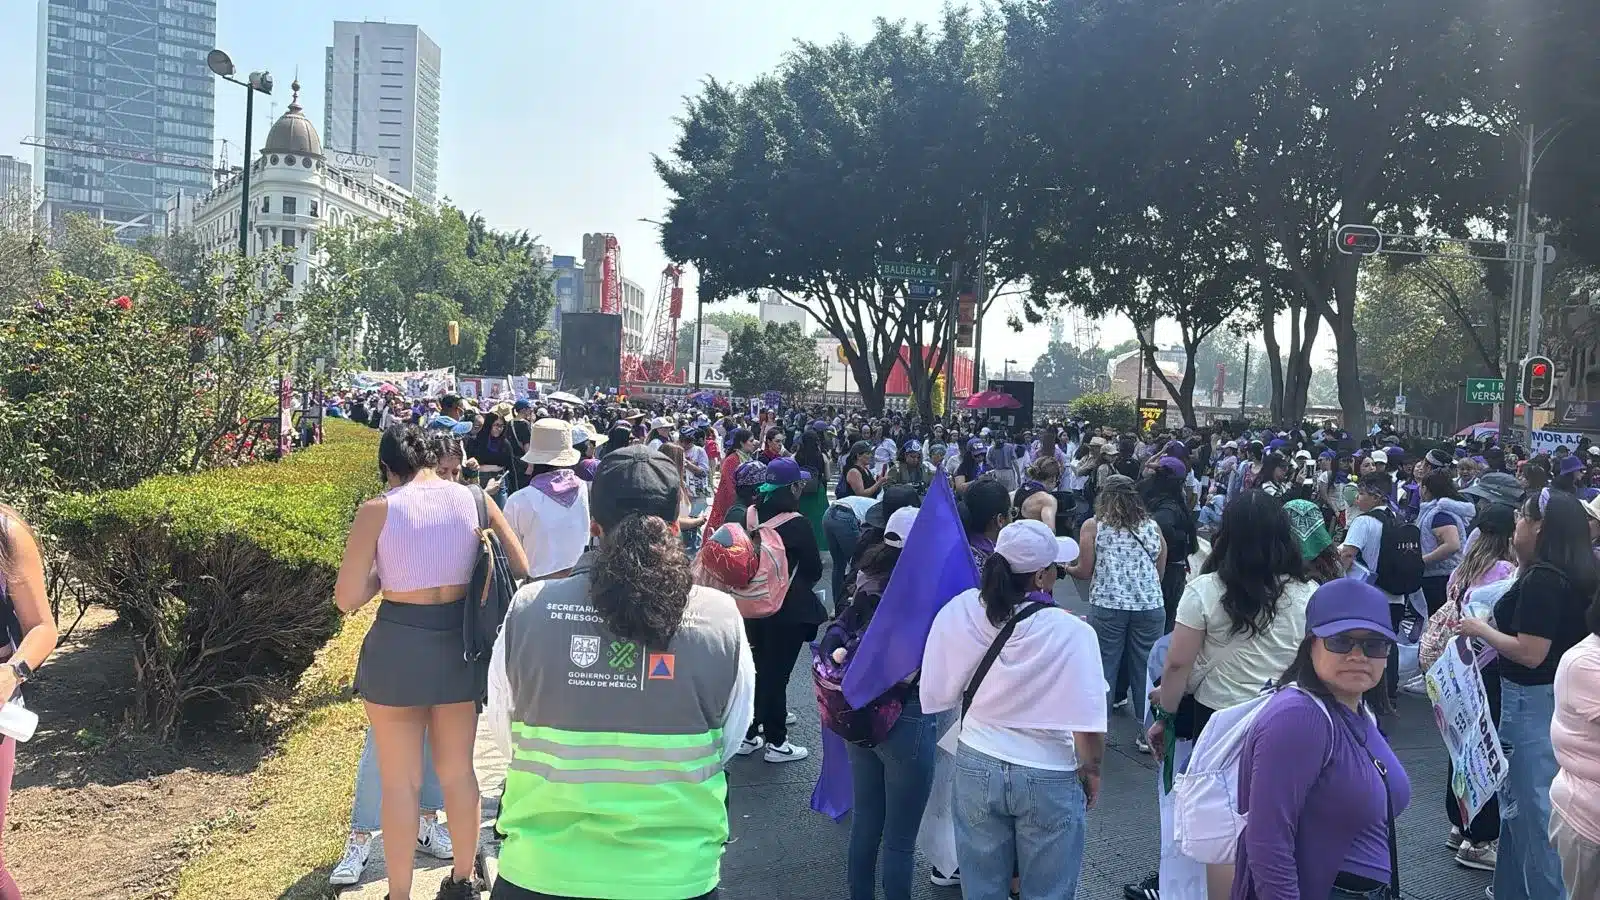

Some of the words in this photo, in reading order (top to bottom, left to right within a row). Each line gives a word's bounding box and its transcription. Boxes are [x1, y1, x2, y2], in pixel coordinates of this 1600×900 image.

[884, 265, 927, 276] BALDERAS
[568, 671, 611, 680] GOBIERNO
[568, 679, 596, 687] CIUDAD
[609, 681, 637, 689] MÉXICO
